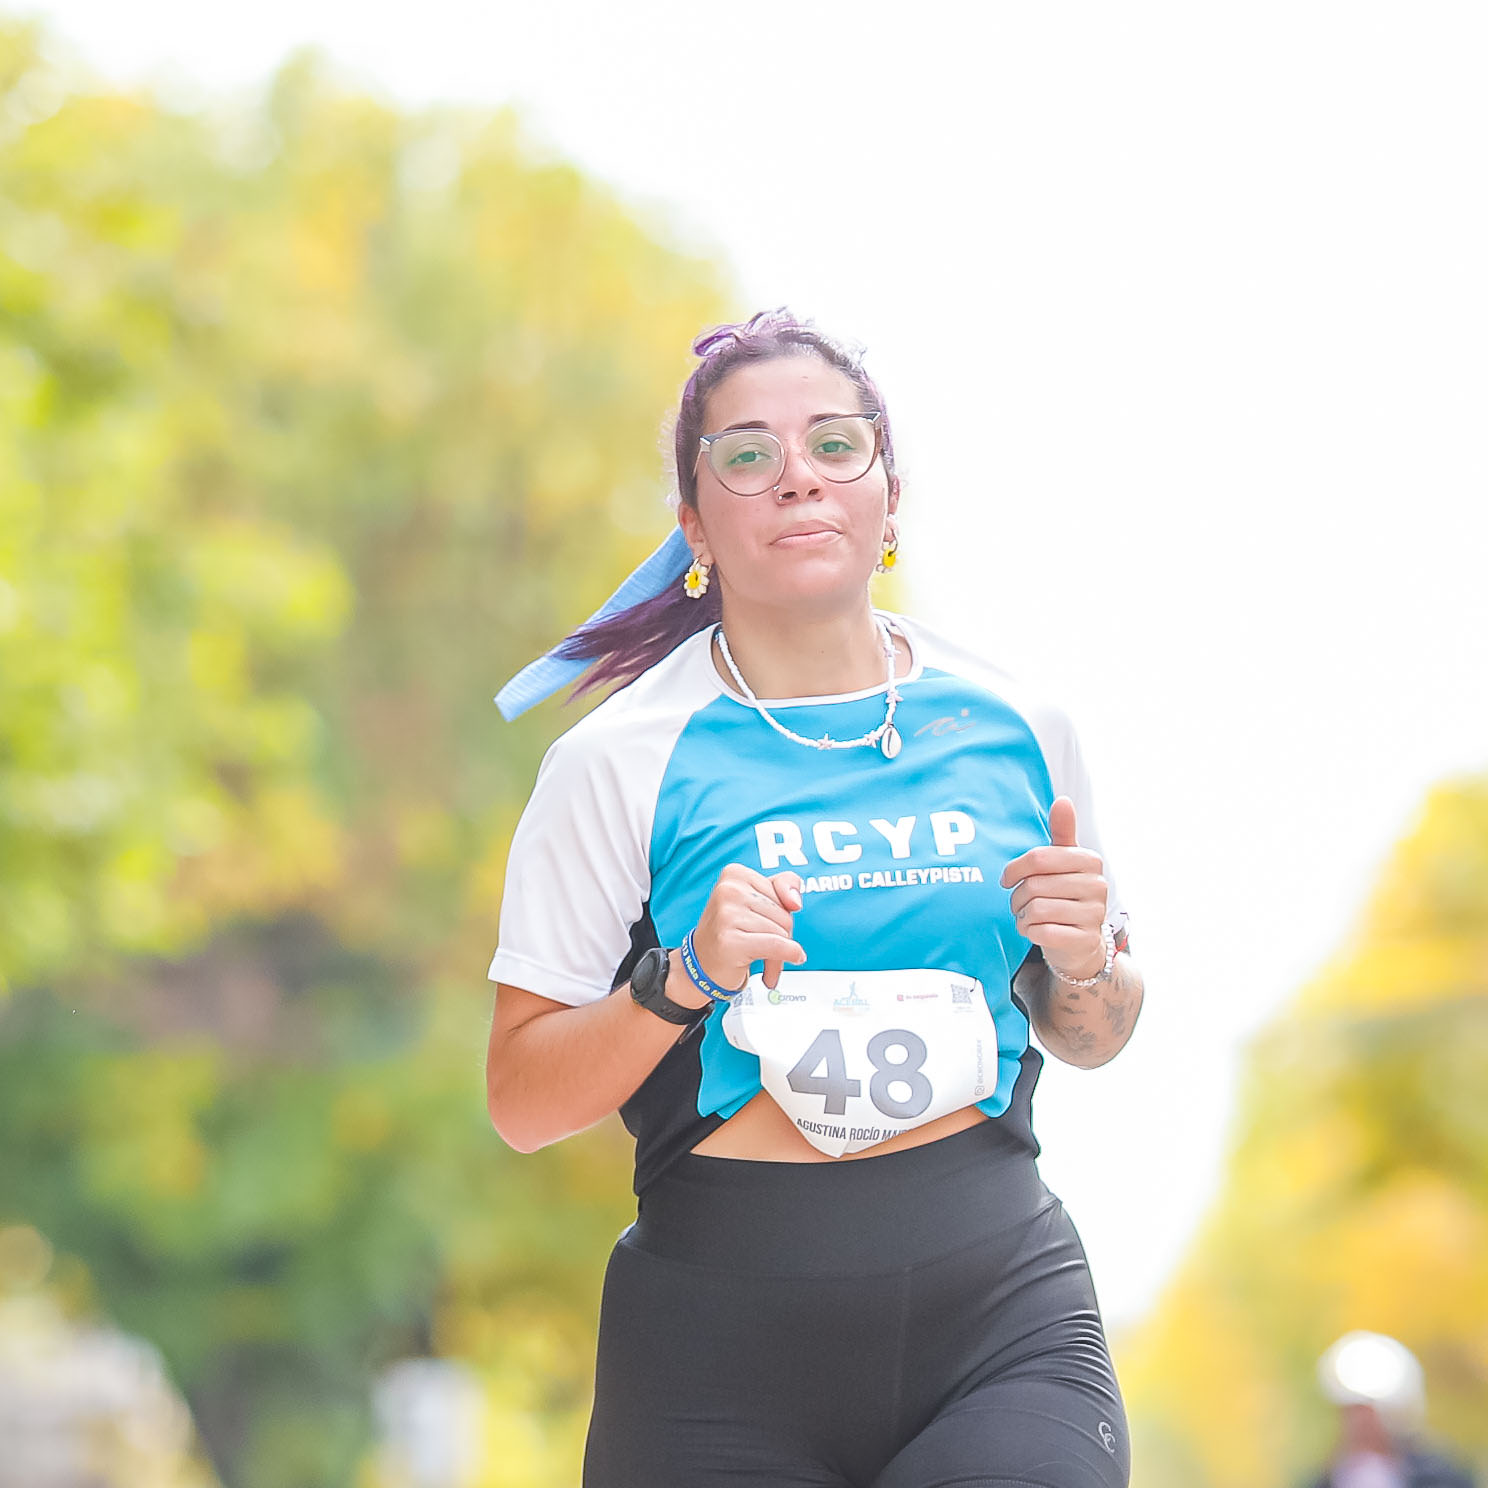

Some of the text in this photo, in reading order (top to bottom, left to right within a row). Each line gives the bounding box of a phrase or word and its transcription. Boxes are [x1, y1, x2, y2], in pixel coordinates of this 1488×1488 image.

[754, 810, 976, 869] RCYP
[800, 867, 984, 894] ARIO CALLEYPISTA
[786, 1029, 933, 1119] 48
[796, 1118, 846, 1140] AGUSTINA
[849, 1126, 880, 1141] ROCÍO
